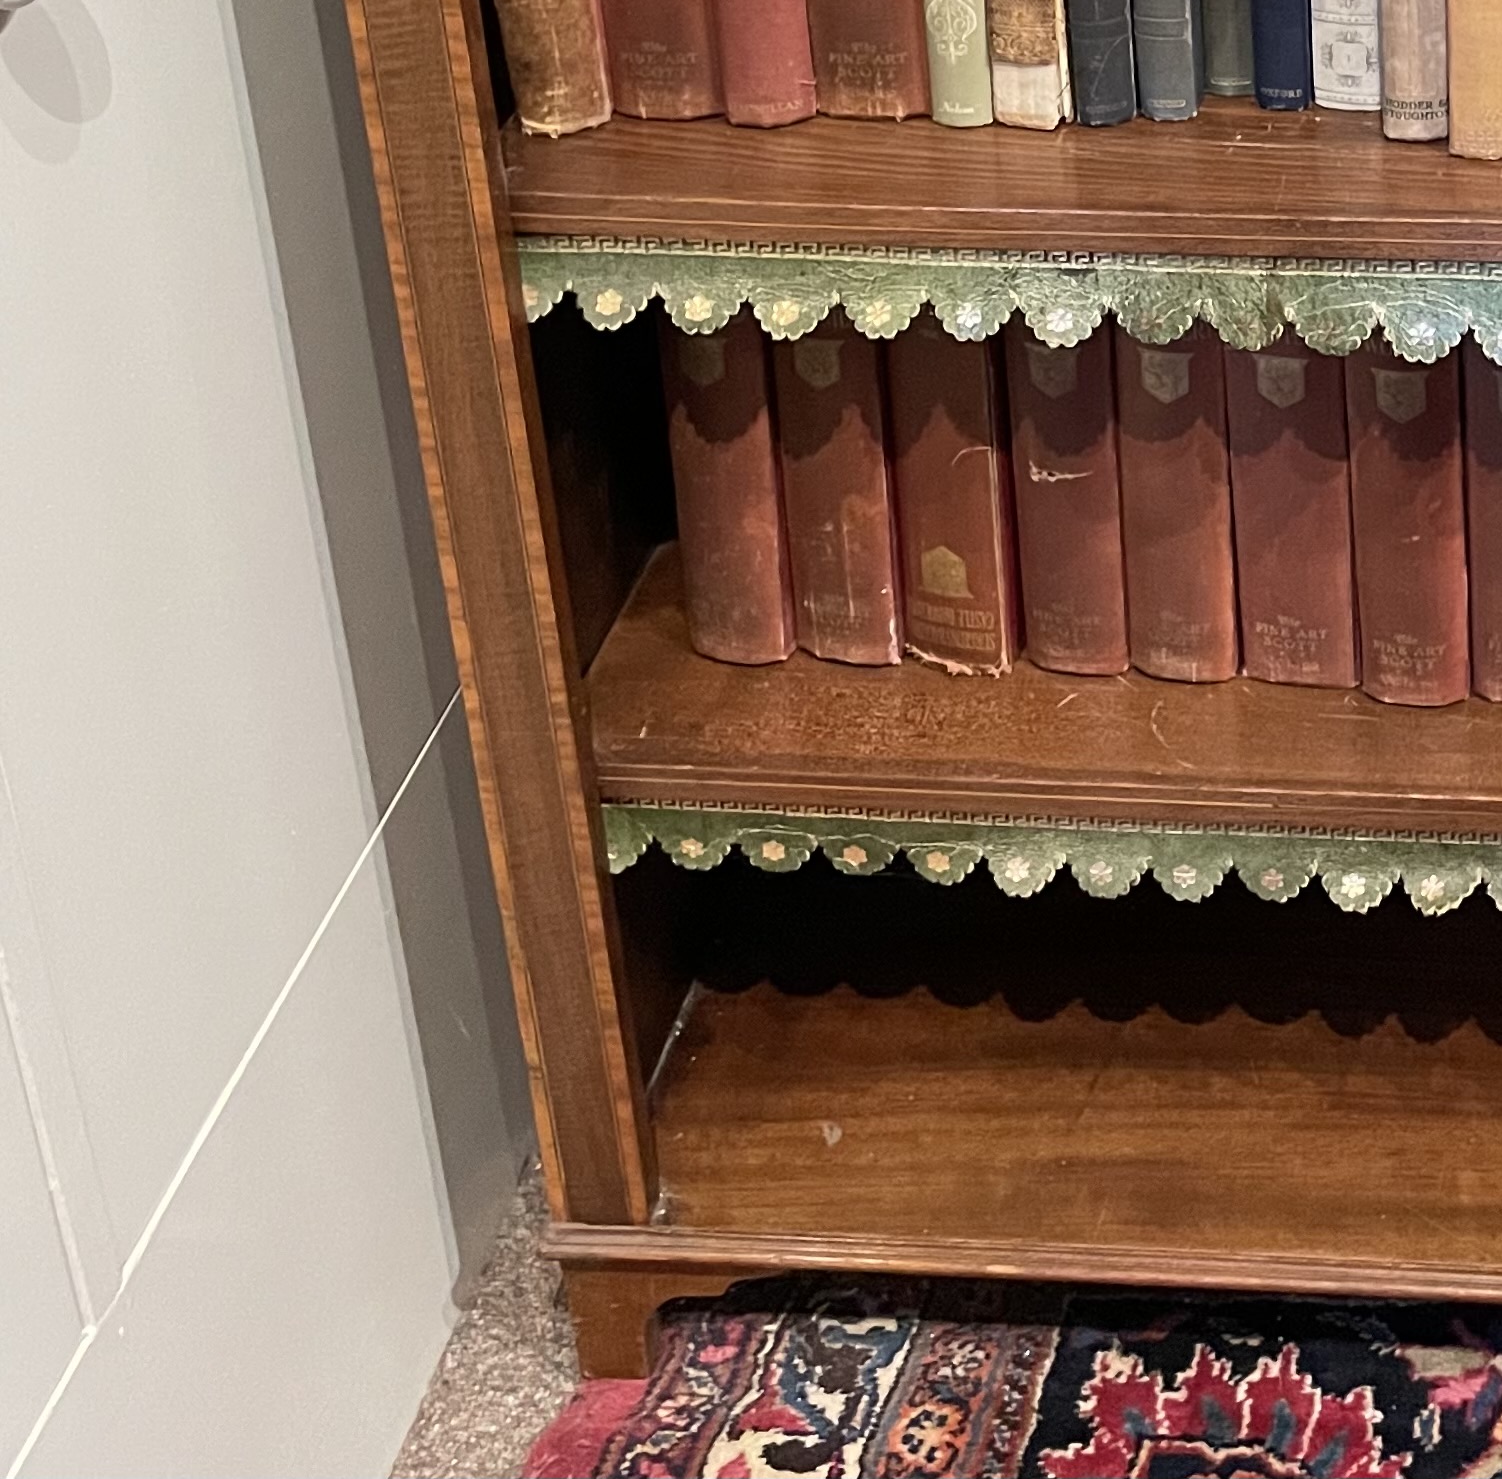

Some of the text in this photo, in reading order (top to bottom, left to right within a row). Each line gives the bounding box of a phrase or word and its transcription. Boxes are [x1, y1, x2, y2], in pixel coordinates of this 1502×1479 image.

[664, 51, 699, 64] ART
[873, 51, 908, 65] ART
[1259, 87, 1304, 98] OXFORD
[1384, 98, 1433, 110] HODDER
[1296, 628, 1328, 641] ART
[1262, 634, 1317, 652] SCOTT
[1412, 644, 1447, 658] ART
[1378, 653, 1437, 671] SCOTT
